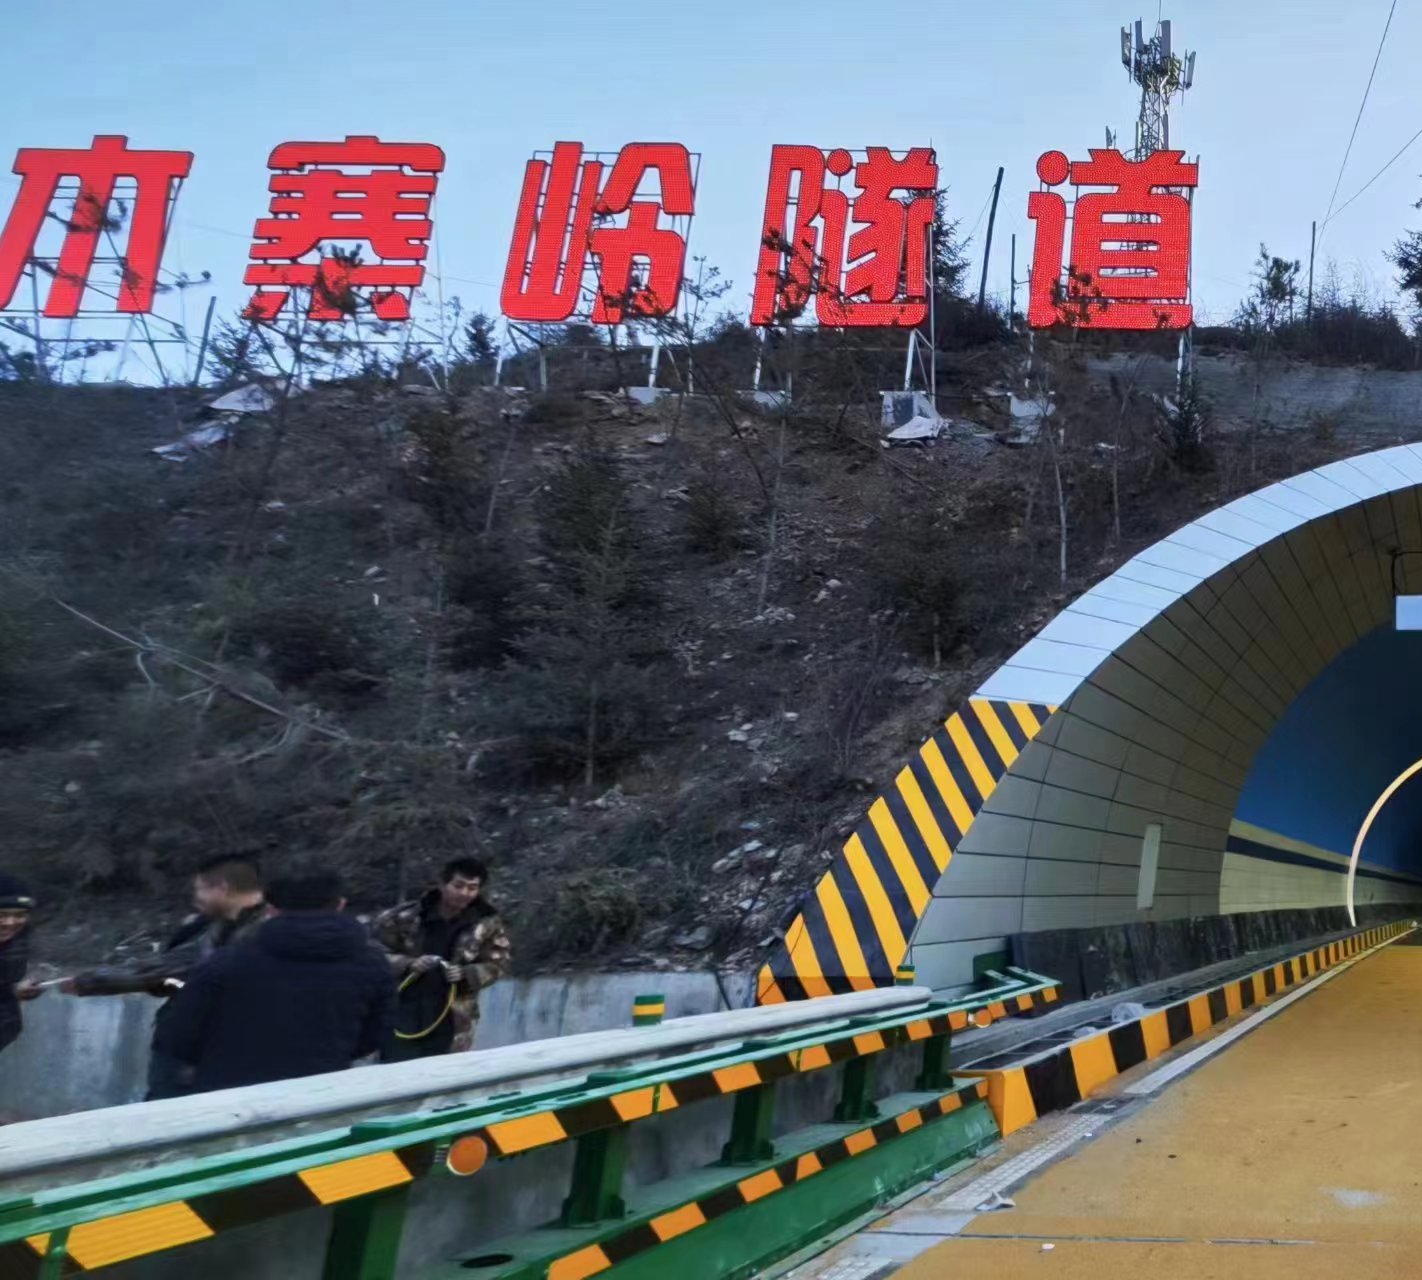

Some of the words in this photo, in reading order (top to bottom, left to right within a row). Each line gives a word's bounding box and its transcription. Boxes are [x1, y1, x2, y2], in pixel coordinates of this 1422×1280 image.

[0, 134, 1199, 330] 木寨岭隧道
